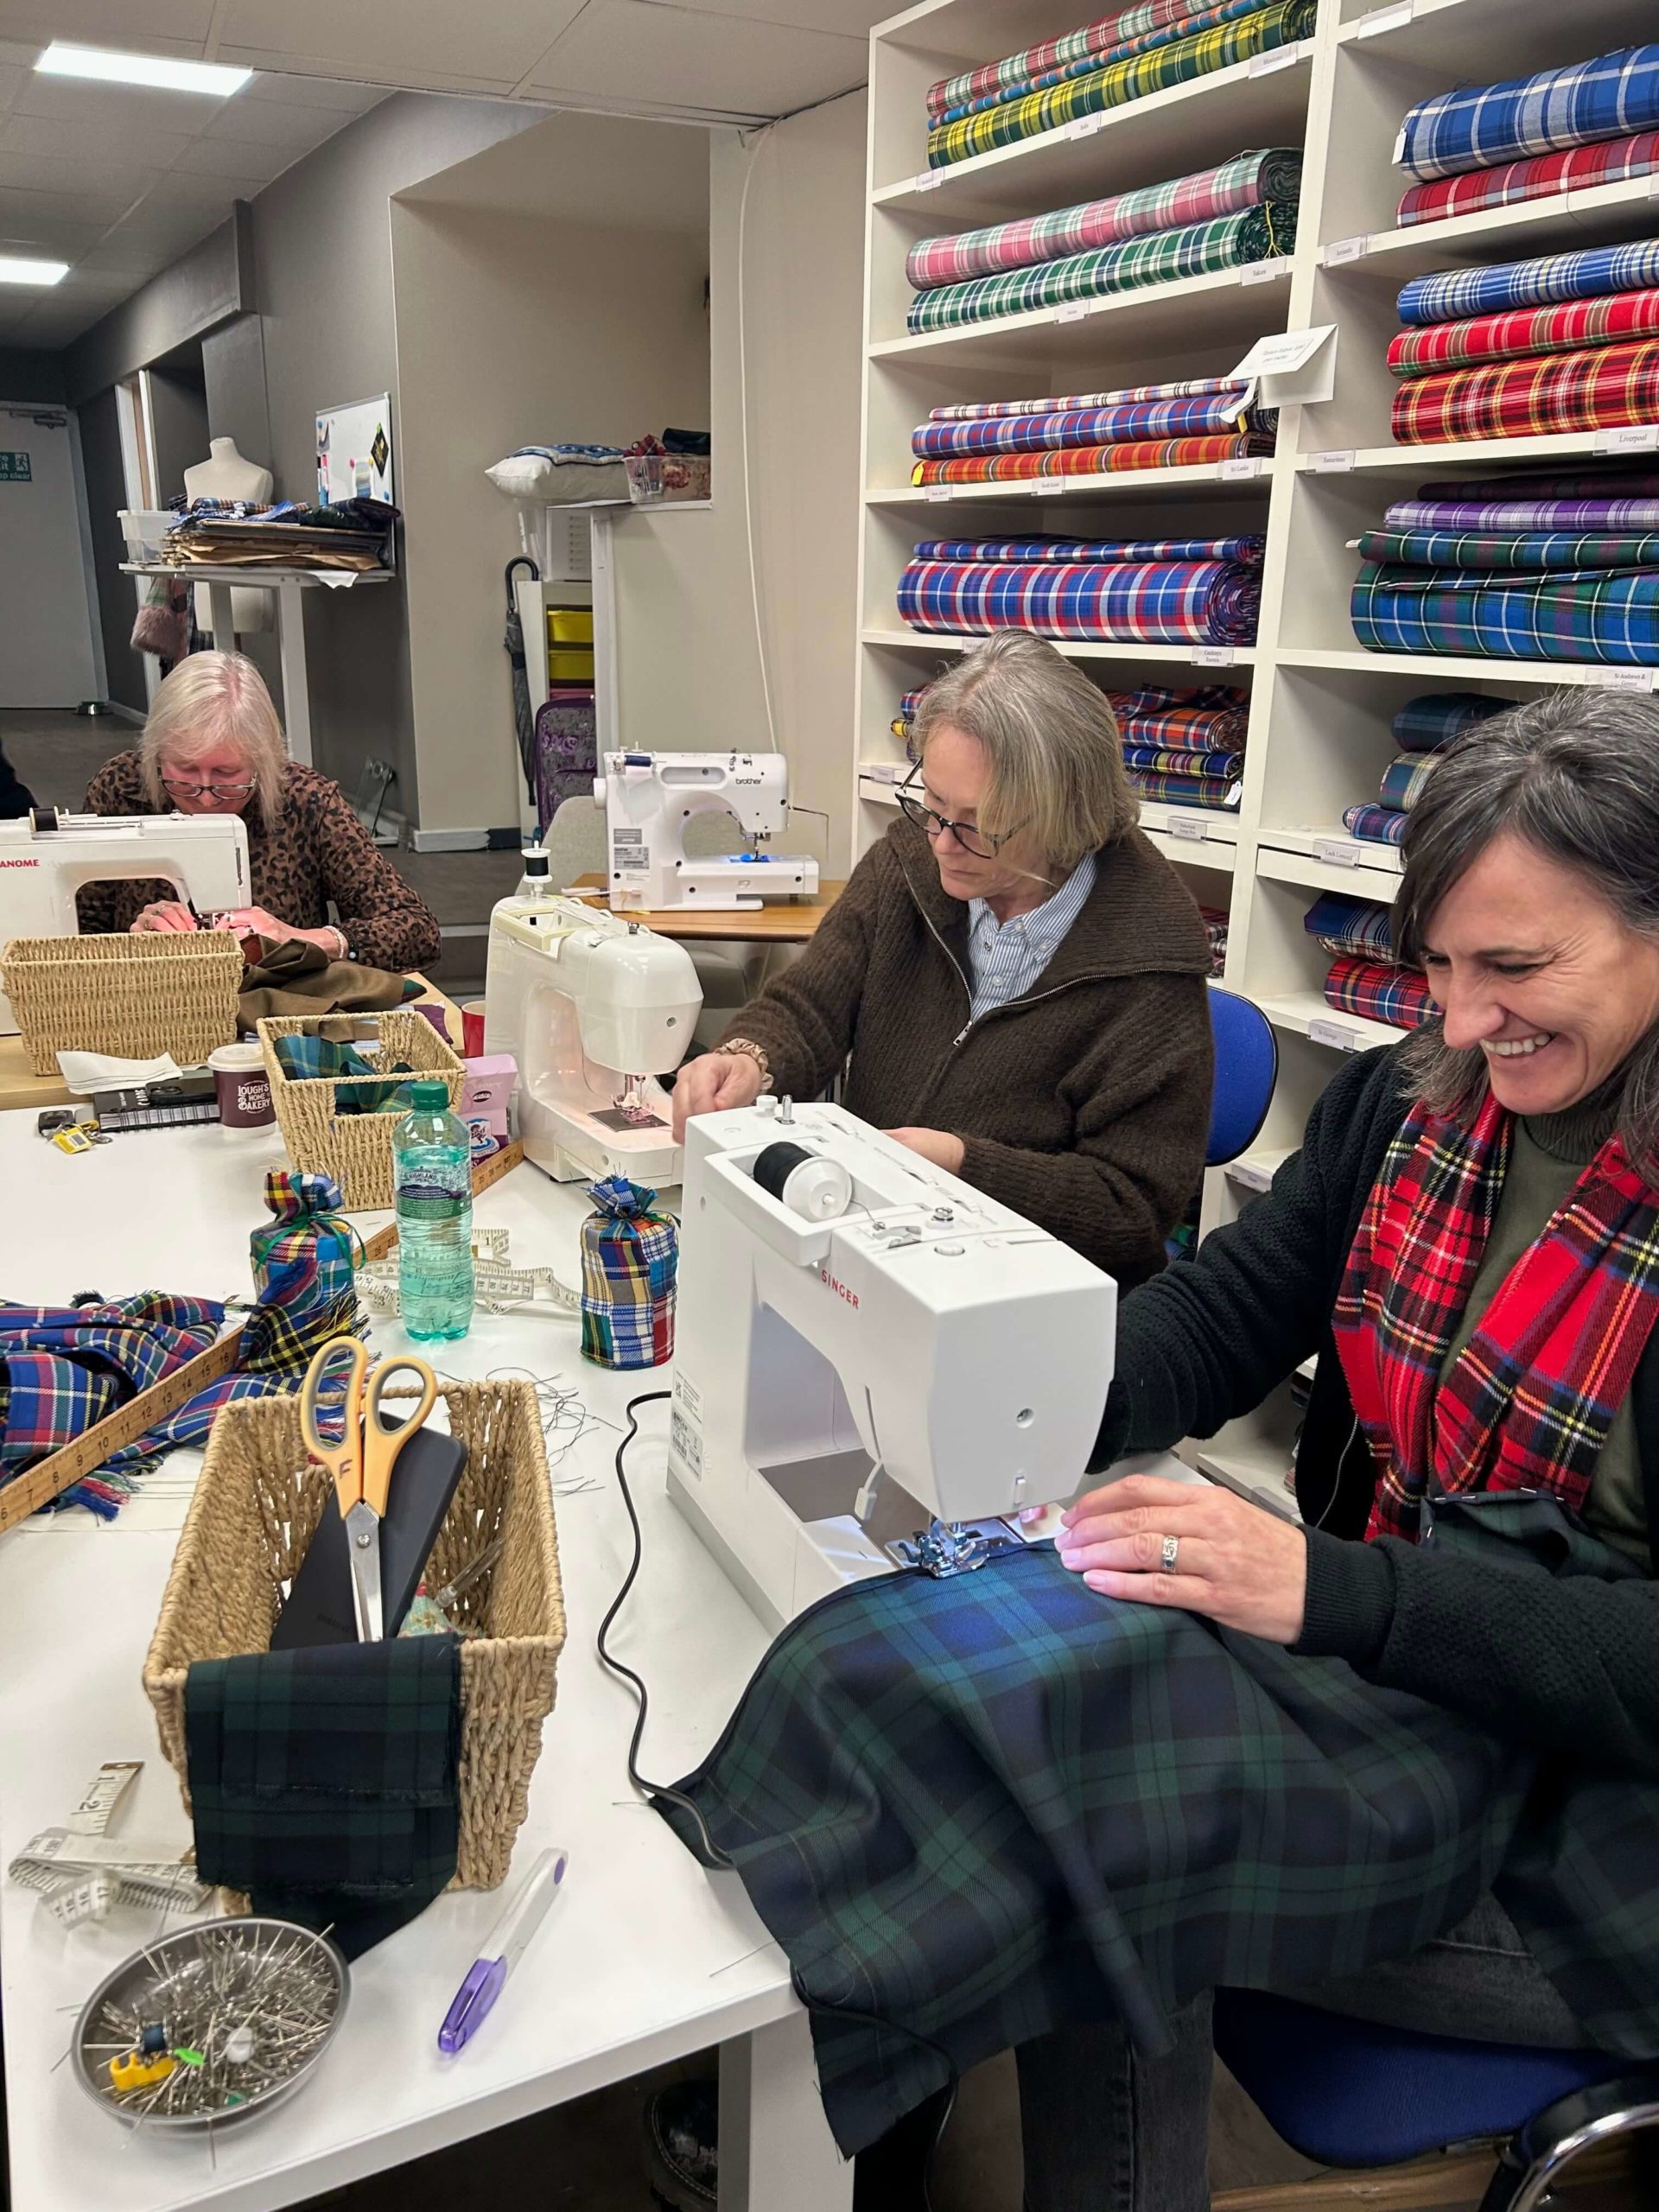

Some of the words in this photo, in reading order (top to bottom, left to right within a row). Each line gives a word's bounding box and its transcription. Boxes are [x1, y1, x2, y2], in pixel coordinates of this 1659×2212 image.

[1619, 434, 1647, 443] Liverpool
[0, 859, 40, 868] ANOME
[248, 1093, 265, 1102] HOME
[545, 1274, 551, 1283] 4
[822, 1269, 859, 1310] SINGER
[219, 1352, 229, 1363] 16
[201, 1366, 211, 1377] 15
[181, 1379, 192, 1389] 14
[162, 1394, 172, 1405] 13
[142, 1406, 152, 1419] 12
[120, 1424, 130, 1435] 11
[98, 1437, 109, 1449] 10
[76, 1455, 83, 1465] 9
[53, 1471, 60, 1482] 8
[27, 1488, 34, 1497] 7
[0, 1507, 7, 1520] 6
[79, 1799, 100, 1811] 2
